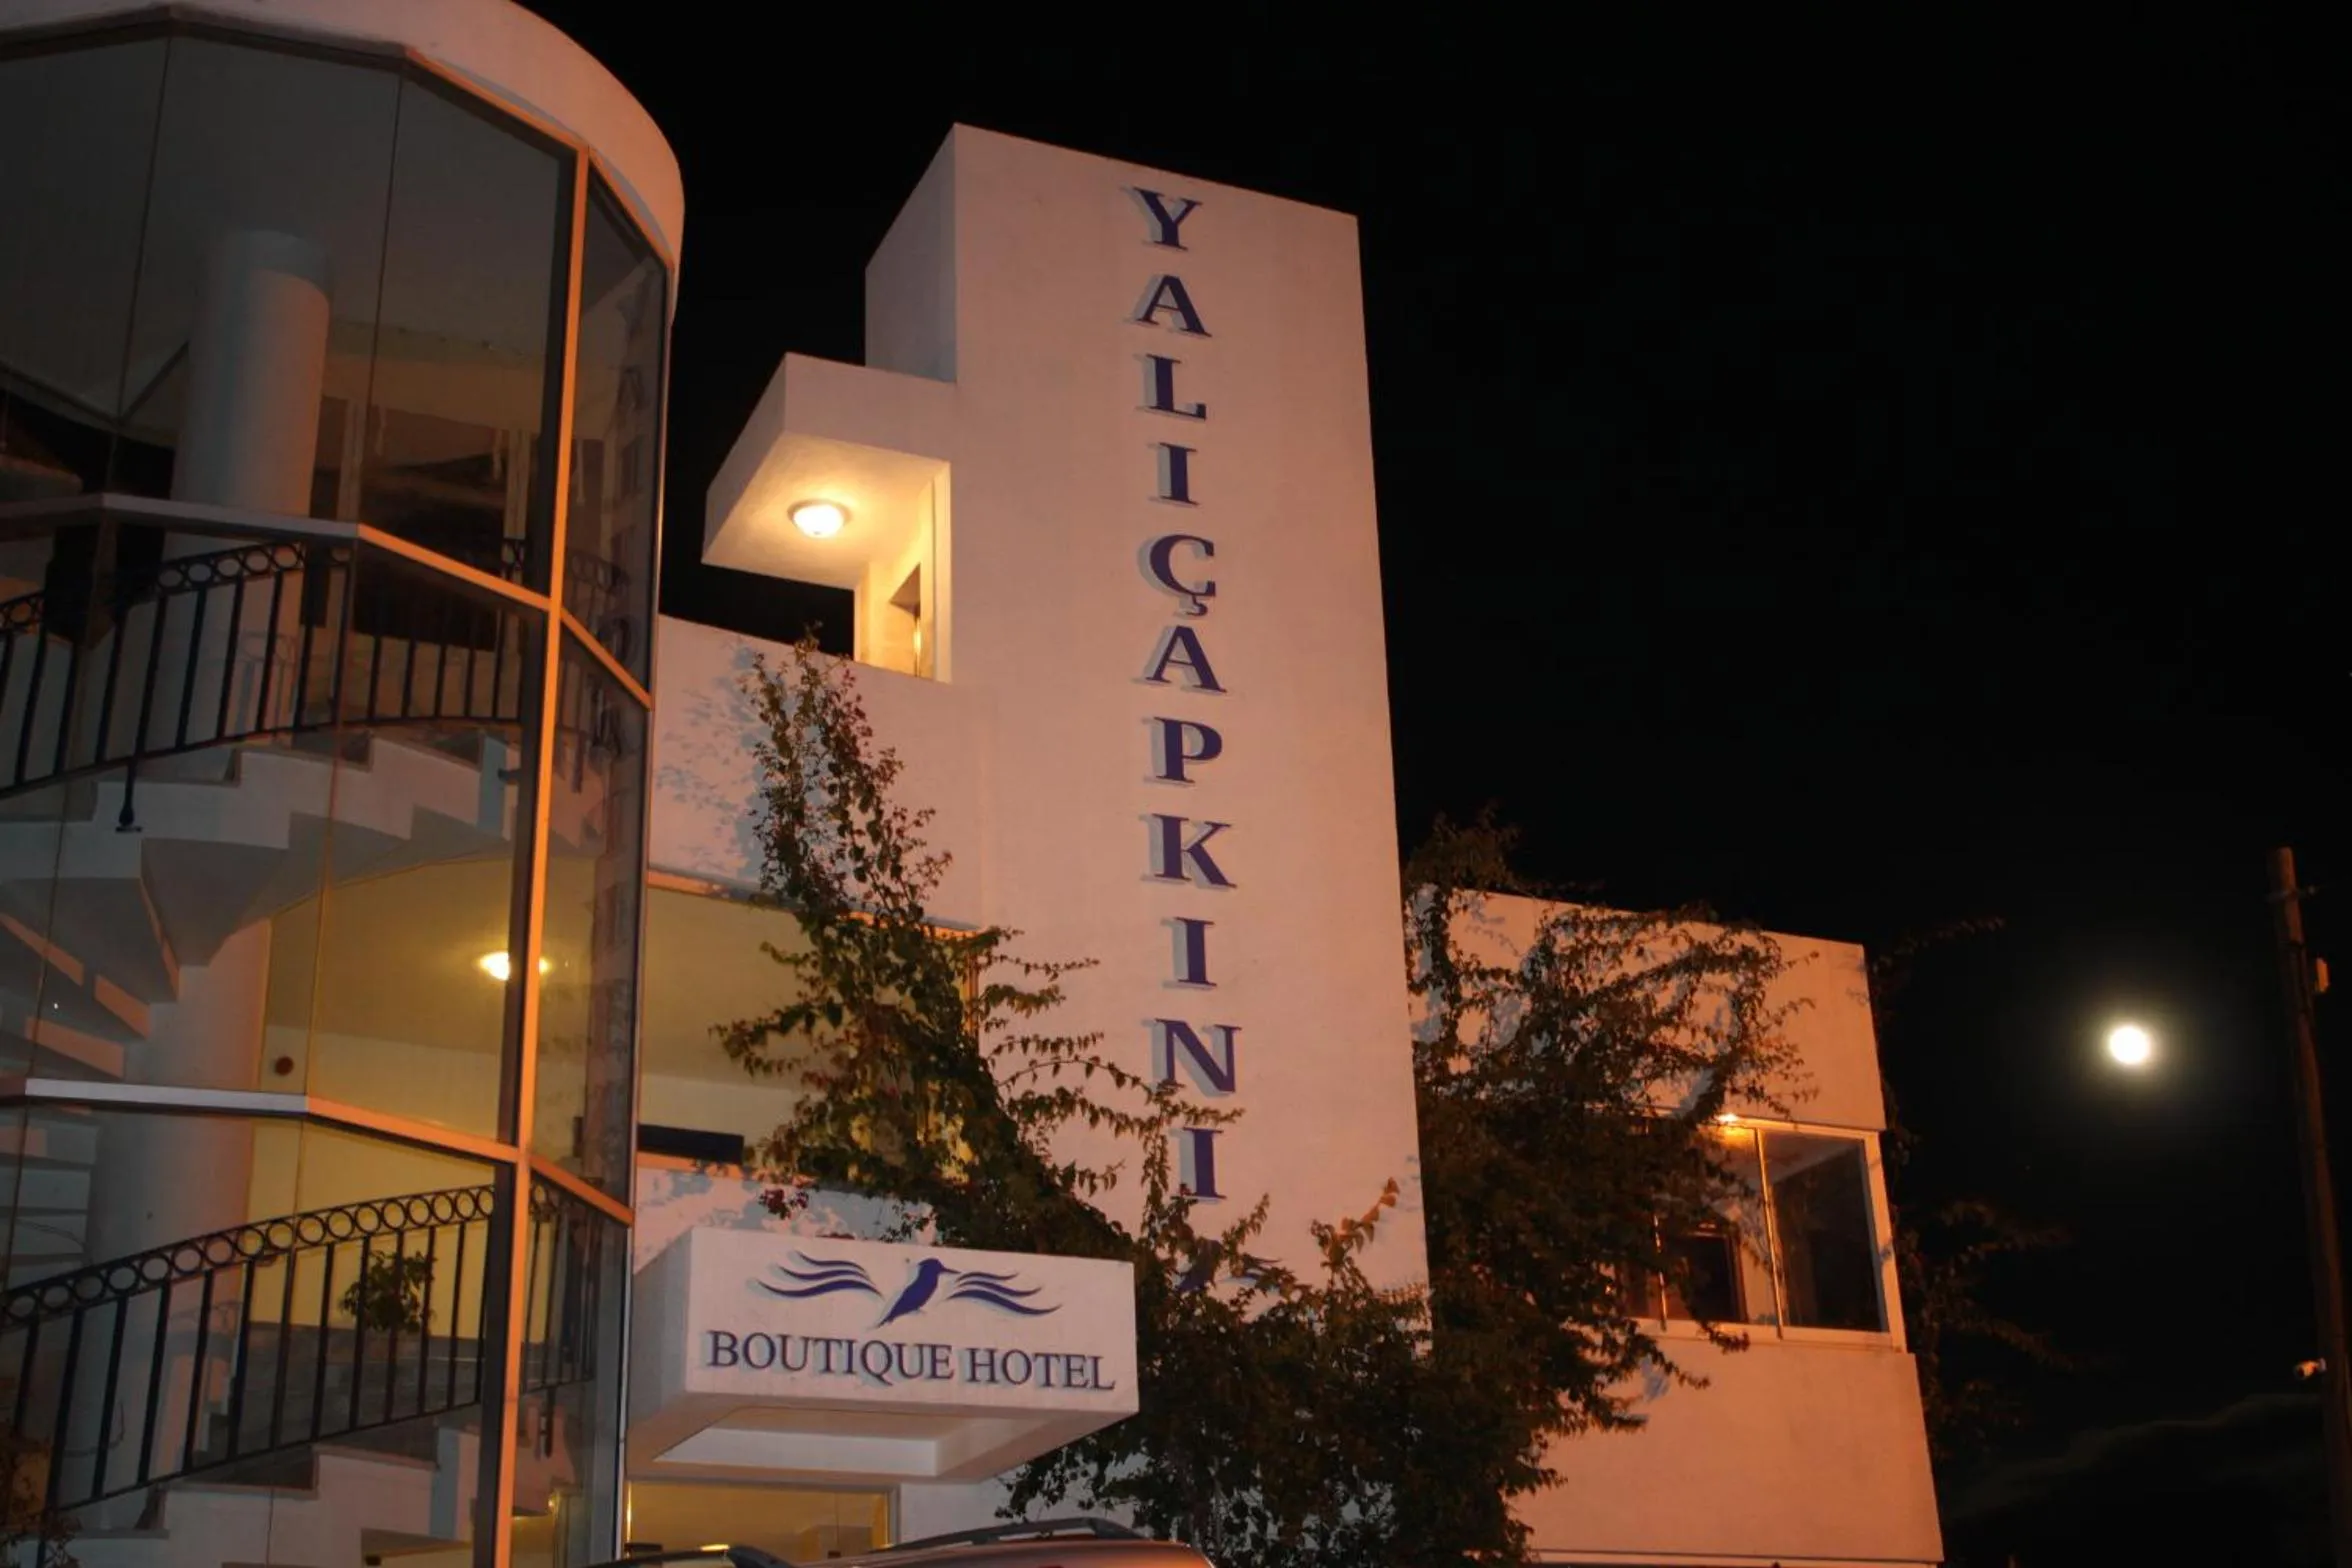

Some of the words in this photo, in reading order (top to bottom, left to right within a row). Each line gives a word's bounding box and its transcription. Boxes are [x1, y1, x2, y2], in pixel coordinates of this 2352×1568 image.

[1132, 186, 1242, 1200] YALIÇAPKINI
[707, 1330, 954, 1387] BOUTIQUE
[965, 1347, 1116, 1391] HOTEL
